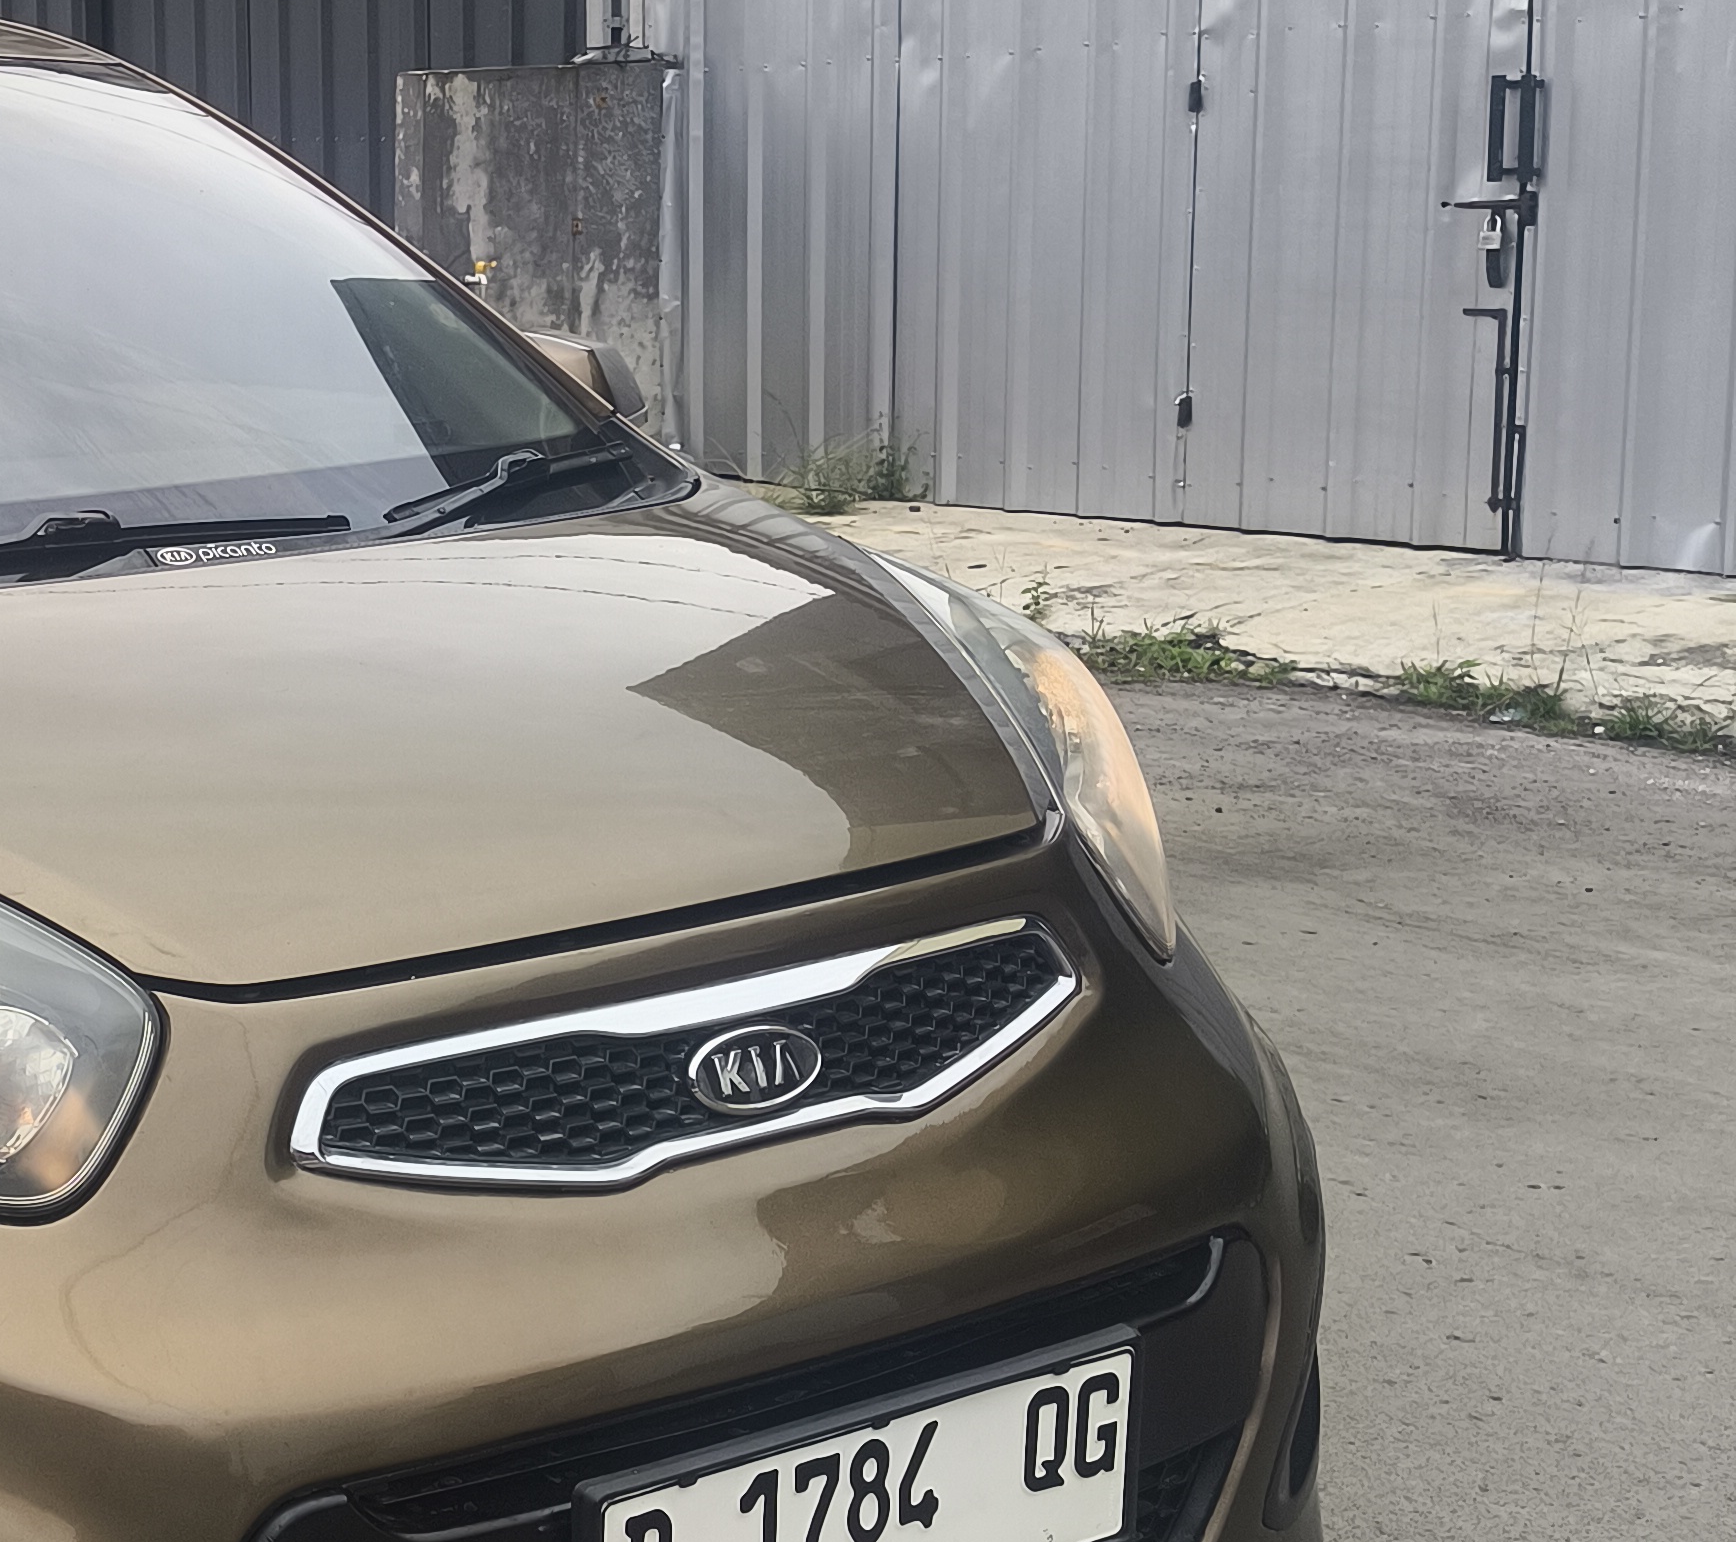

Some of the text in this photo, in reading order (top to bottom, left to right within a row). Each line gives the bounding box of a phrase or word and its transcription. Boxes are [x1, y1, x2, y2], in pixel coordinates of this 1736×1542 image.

[161, 541, 277, 563] KIA picanto
[706, 1035, 804, 1101] KIA
[1023, 1371, 1121, 1493] QG
